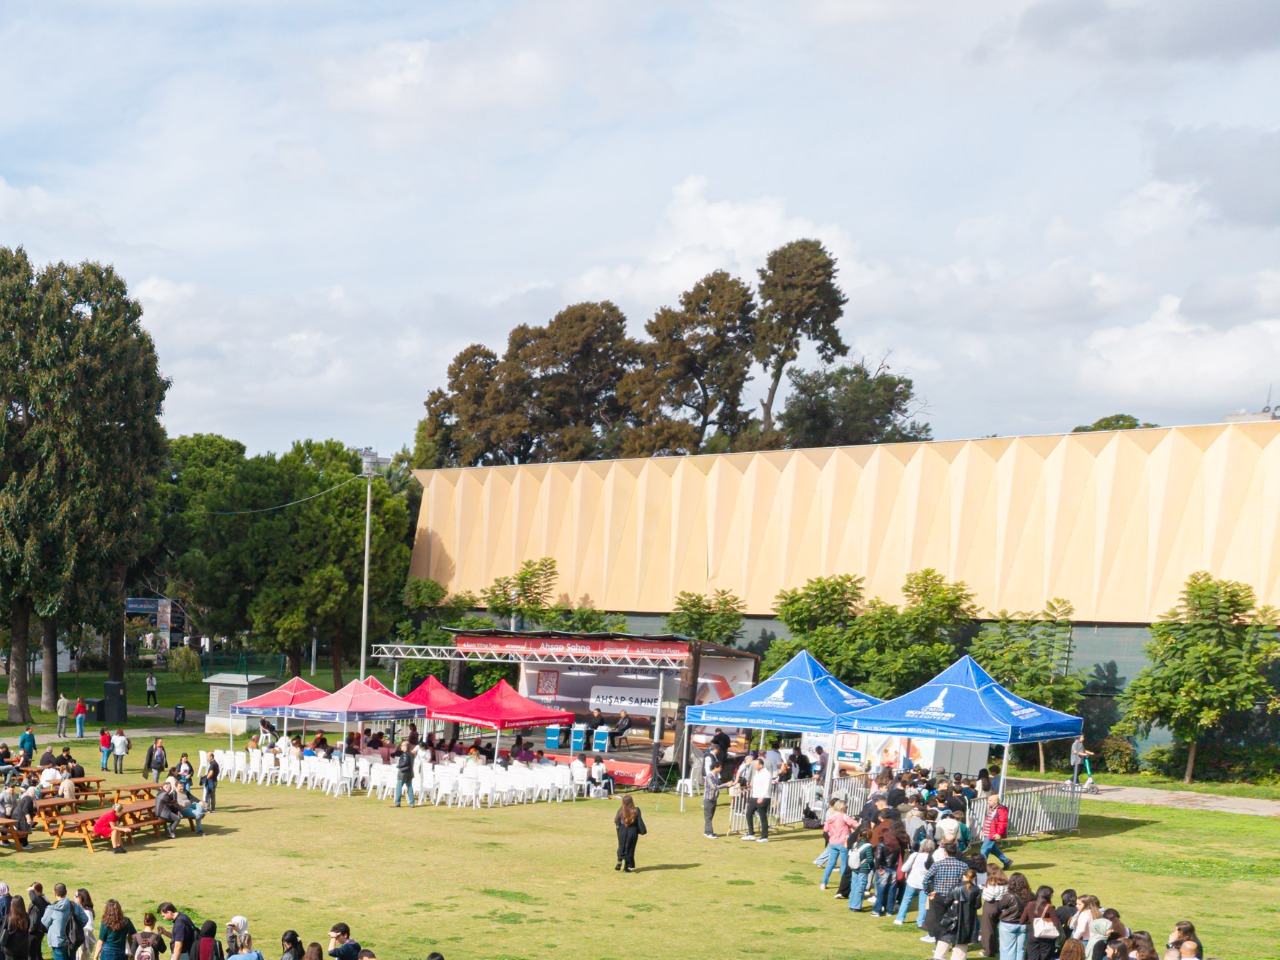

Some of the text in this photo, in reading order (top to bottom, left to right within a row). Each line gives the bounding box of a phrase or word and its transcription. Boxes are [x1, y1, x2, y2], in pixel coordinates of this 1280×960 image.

[567, 643, 590, 652] Sahne
[595, 695, 659, 706] AHŞAP SAHNE
